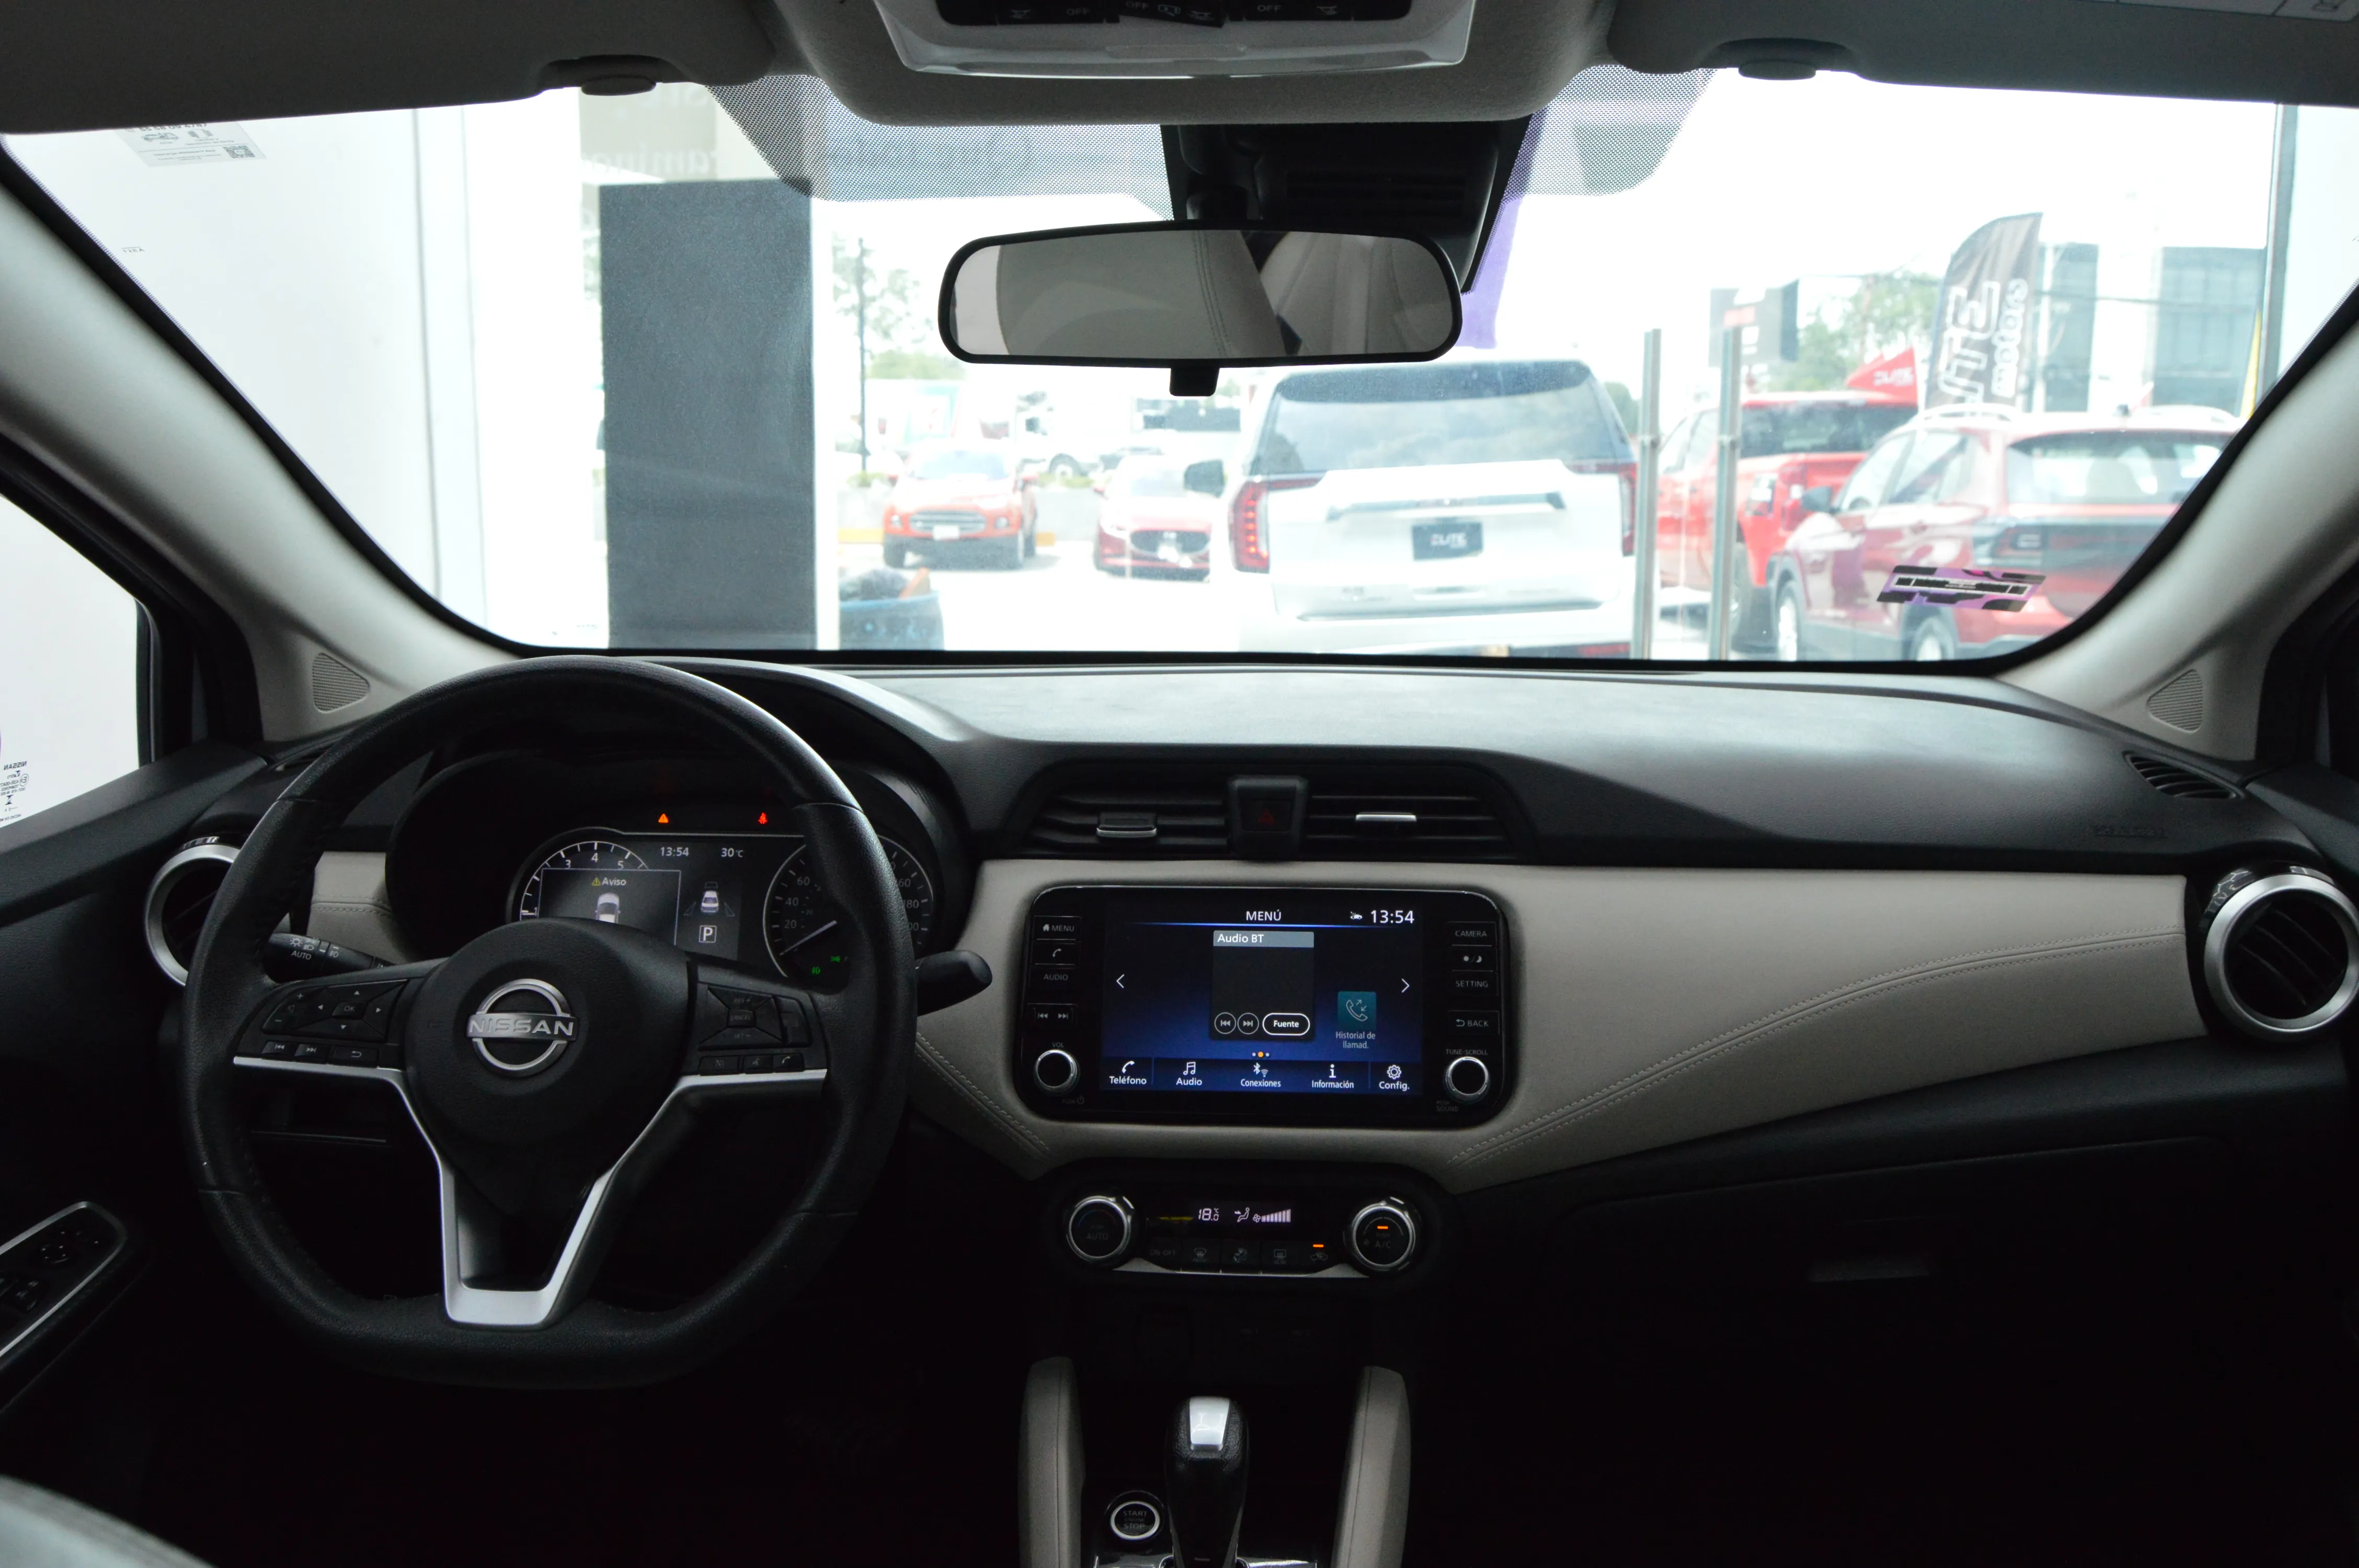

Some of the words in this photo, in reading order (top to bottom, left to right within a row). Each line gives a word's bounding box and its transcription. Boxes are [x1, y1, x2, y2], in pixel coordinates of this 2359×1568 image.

[1126, 1, 1149, 9] OFF
[1256, 4, 1282, 12] OFF
[1066, 7, 1090, 16] OFF
[660, 846, 690, 857] 13:54
[591, 852, 599, 862] 4
[565, 859, 571, 869] 3
[617, 861, 624, 870] 5
[601, 877, 627, 886] Aviso
[796, 877, 810, 886] 60
[896, 878, 911, 887] 60
[785, 896, 799, 906] 40
[1246, 909, 1282, 921] MENÚ
[1370, 910, 1414, 924] 13:54
[784, 919, 797, 929] 20
[702, 926, 713, 941] P
[1217, 933, 1249, 943] Audio
[1251, 934, 1265, 943] BT
[1455, 929, 1487, 938] CAMERA
[291, 950, 312, 961] AUTO
[469, 1018, 574, 1036] NISSAN
[1335, 1031, 1366, 1040] Historial
[1367, 1031, 1376, 1040] de
[1343, 1041, 1369, 1049] llamad.
[1109, 1075, 1147, 1085] Teléfono
[1176, 1077, 1203, 1086] Audio
[1240, 1078, 1281, 1087] Conexiones
[1312, 1079, 1354, 1089] Información
[1379, 1081, 1410, 1091] Config.
[1086, 1232, 1109, 1241] AUTO
[1375, 1240, 1392, 1249] A/C
